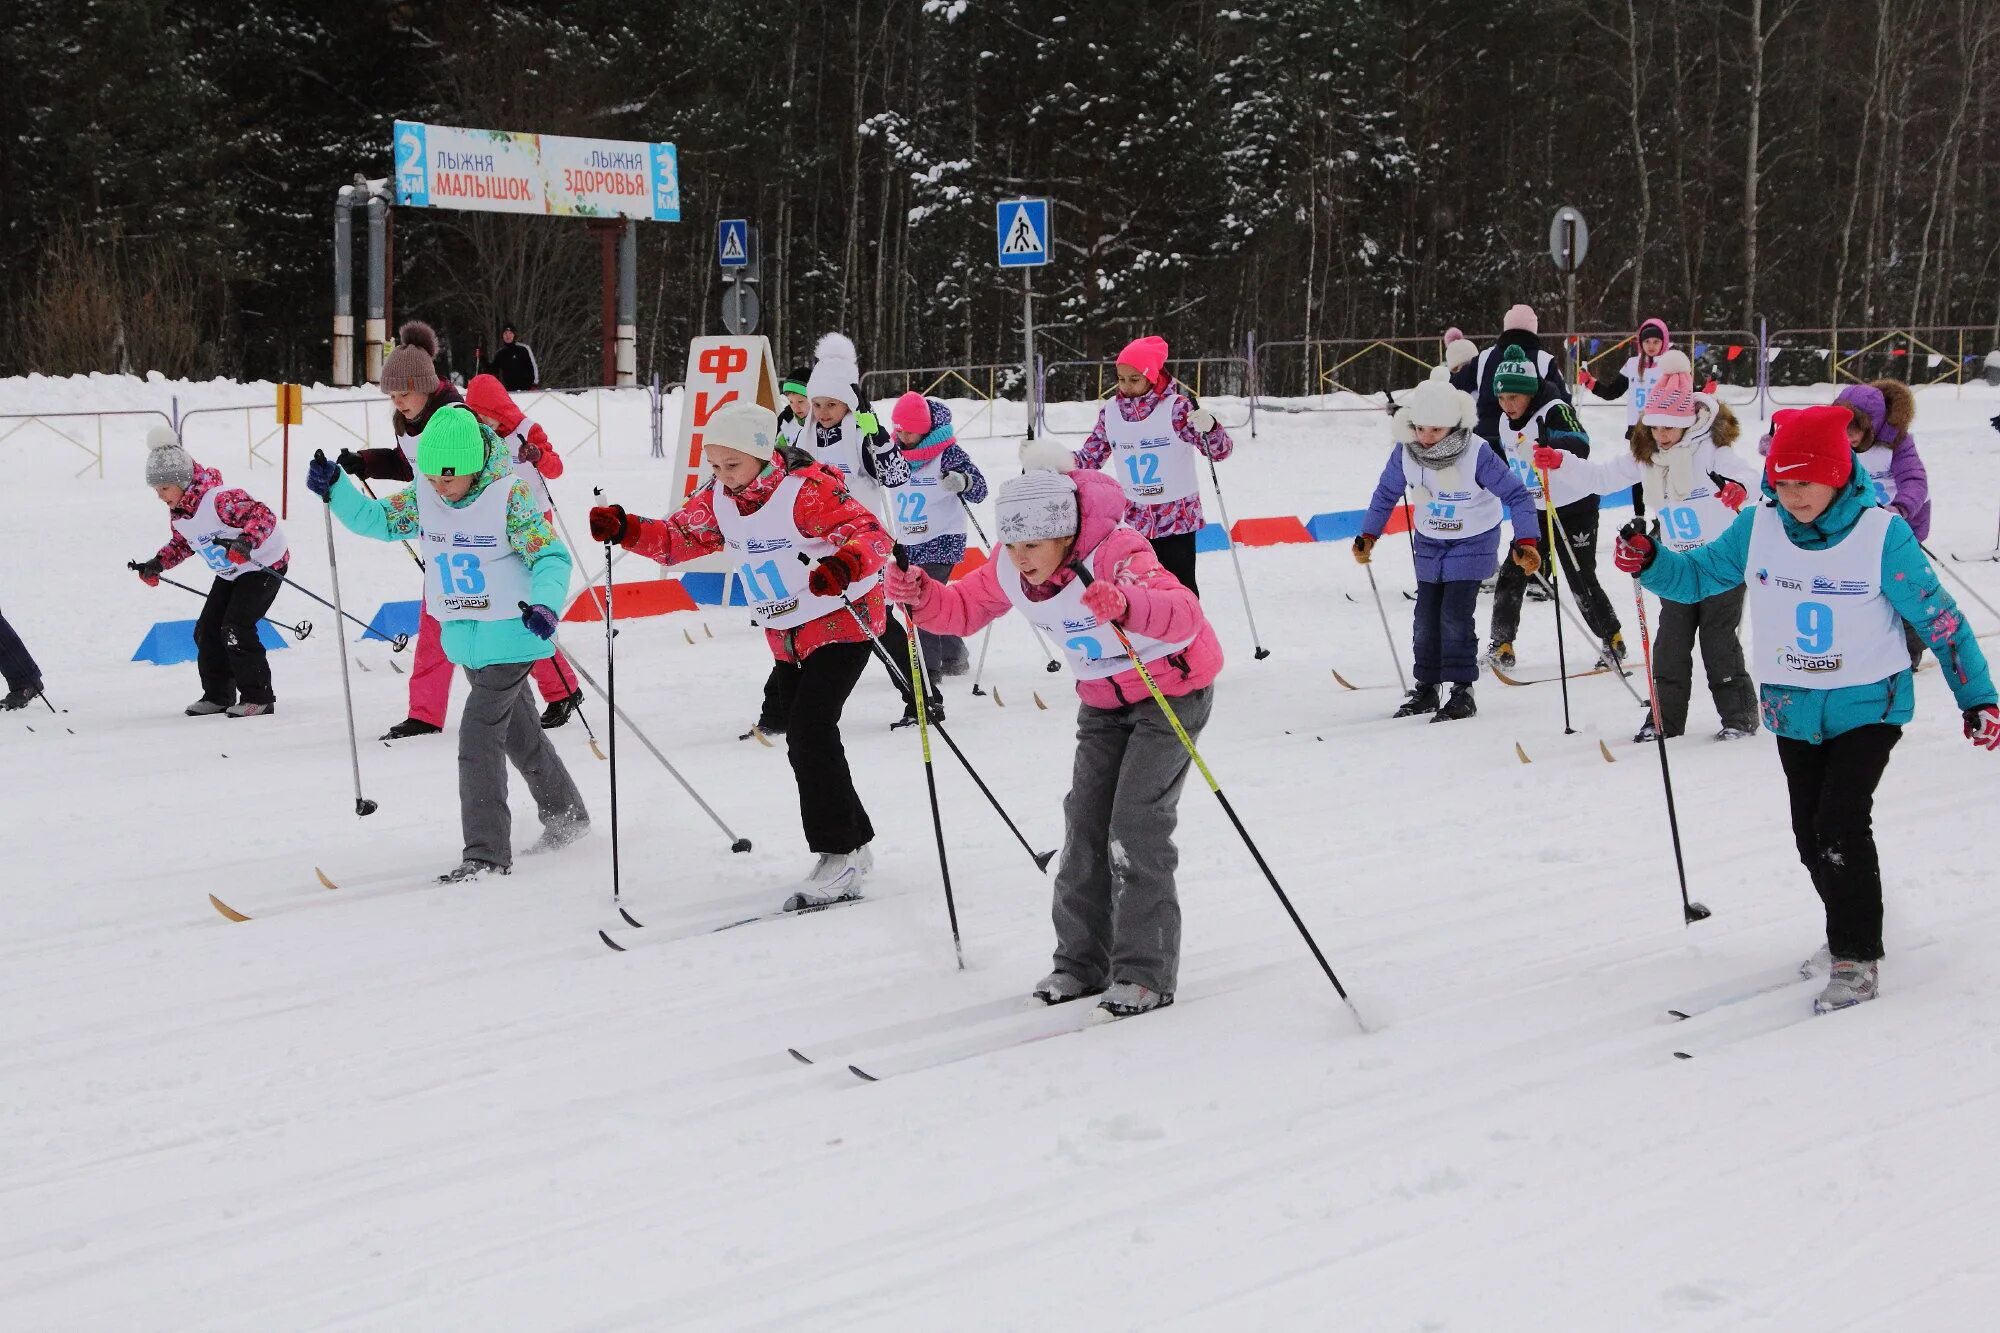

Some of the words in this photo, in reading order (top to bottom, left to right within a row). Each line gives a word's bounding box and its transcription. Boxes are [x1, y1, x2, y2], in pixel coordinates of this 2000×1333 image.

[400, 134, 423, 175] 2
[437, 151, 494, 173] ЛЫЖНЯ
[656, 154, 675, 192] 3
[1125, 453, 1161, 485] 12
[897, 492, 928, 522] 22
[1659, 506, 1701, 540] 19
[433, 552, 486, 595] 13
[741, 560, 790, 601] 11
[1775, 579, 1802, 591] ТВЭЛ
[1796, 602, 1834, 654] 9
[1136, 656, 1158, 689] MAXIM
